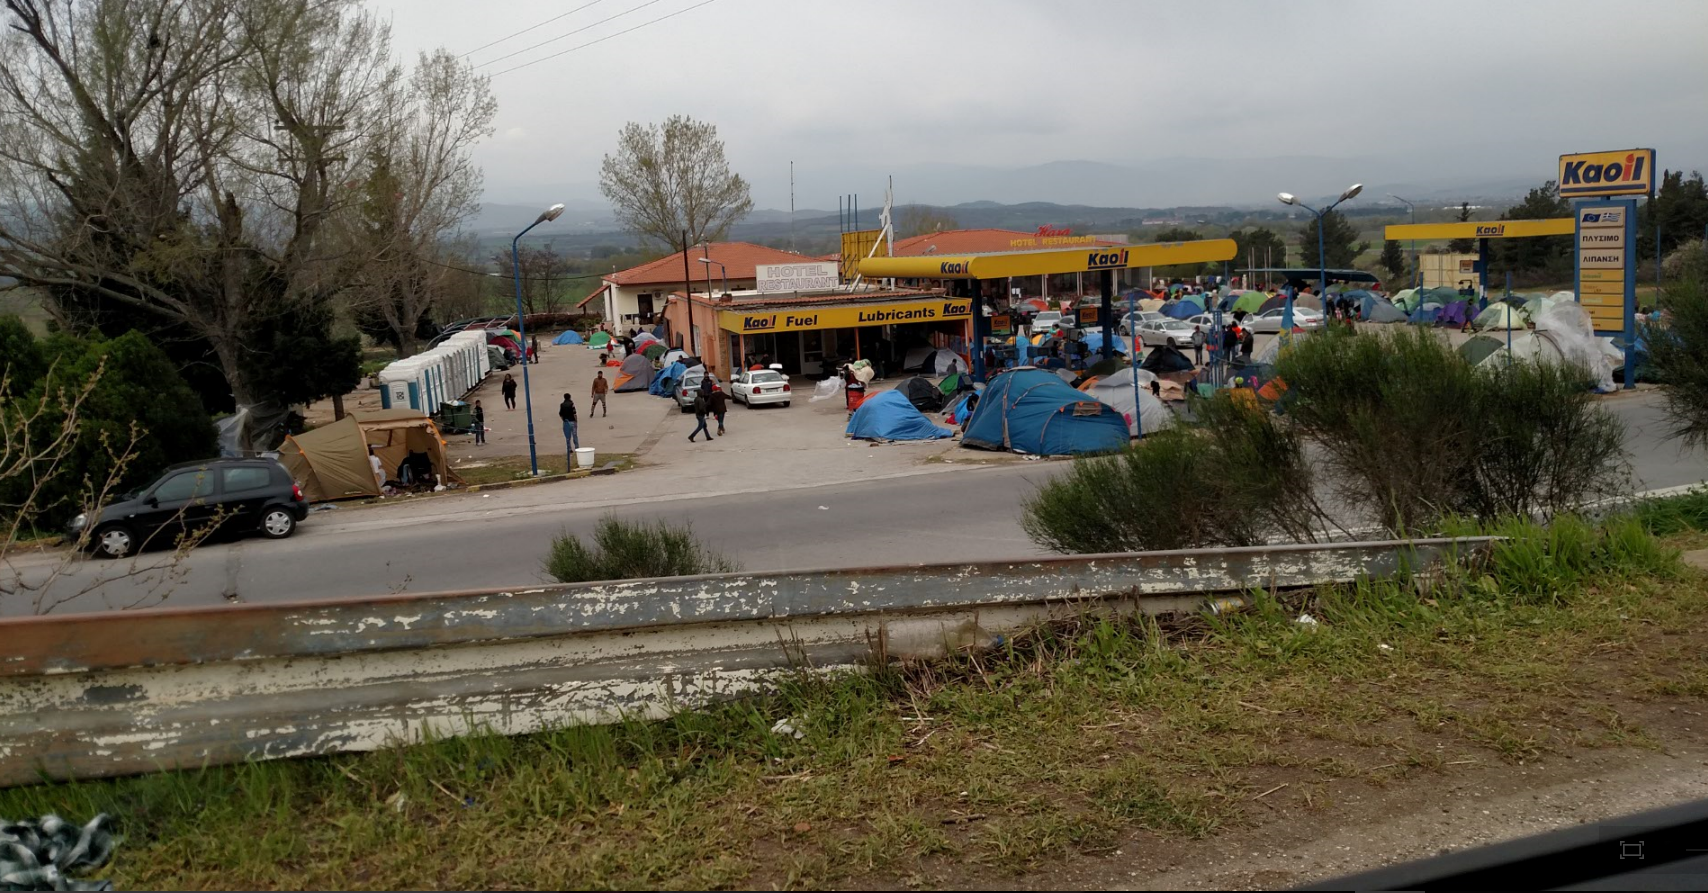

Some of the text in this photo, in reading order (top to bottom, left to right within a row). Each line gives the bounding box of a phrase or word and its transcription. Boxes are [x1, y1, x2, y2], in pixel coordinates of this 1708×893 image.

[1562, 153, 1645, 185] Kaoil
[1476, 224, 1505, 234] Kaoil
[1010, 236, 1097, 247] HOTEL RESTAURANT
[1582, 235, 1620, 243] ΠΛΥΣΙΜΟ
[1088, 248, 1129, 266] Kaoil
[767, 265, 828, 278] HOTEL
[940, 260, 970, 274] Kaoil
[757, 277, 838, 291] RESTAURANT
[743, 314, 777, 328] Kaoil
[786, 314, 818, 327] Fuel
[858, 307, 936, 322] Lubricants
